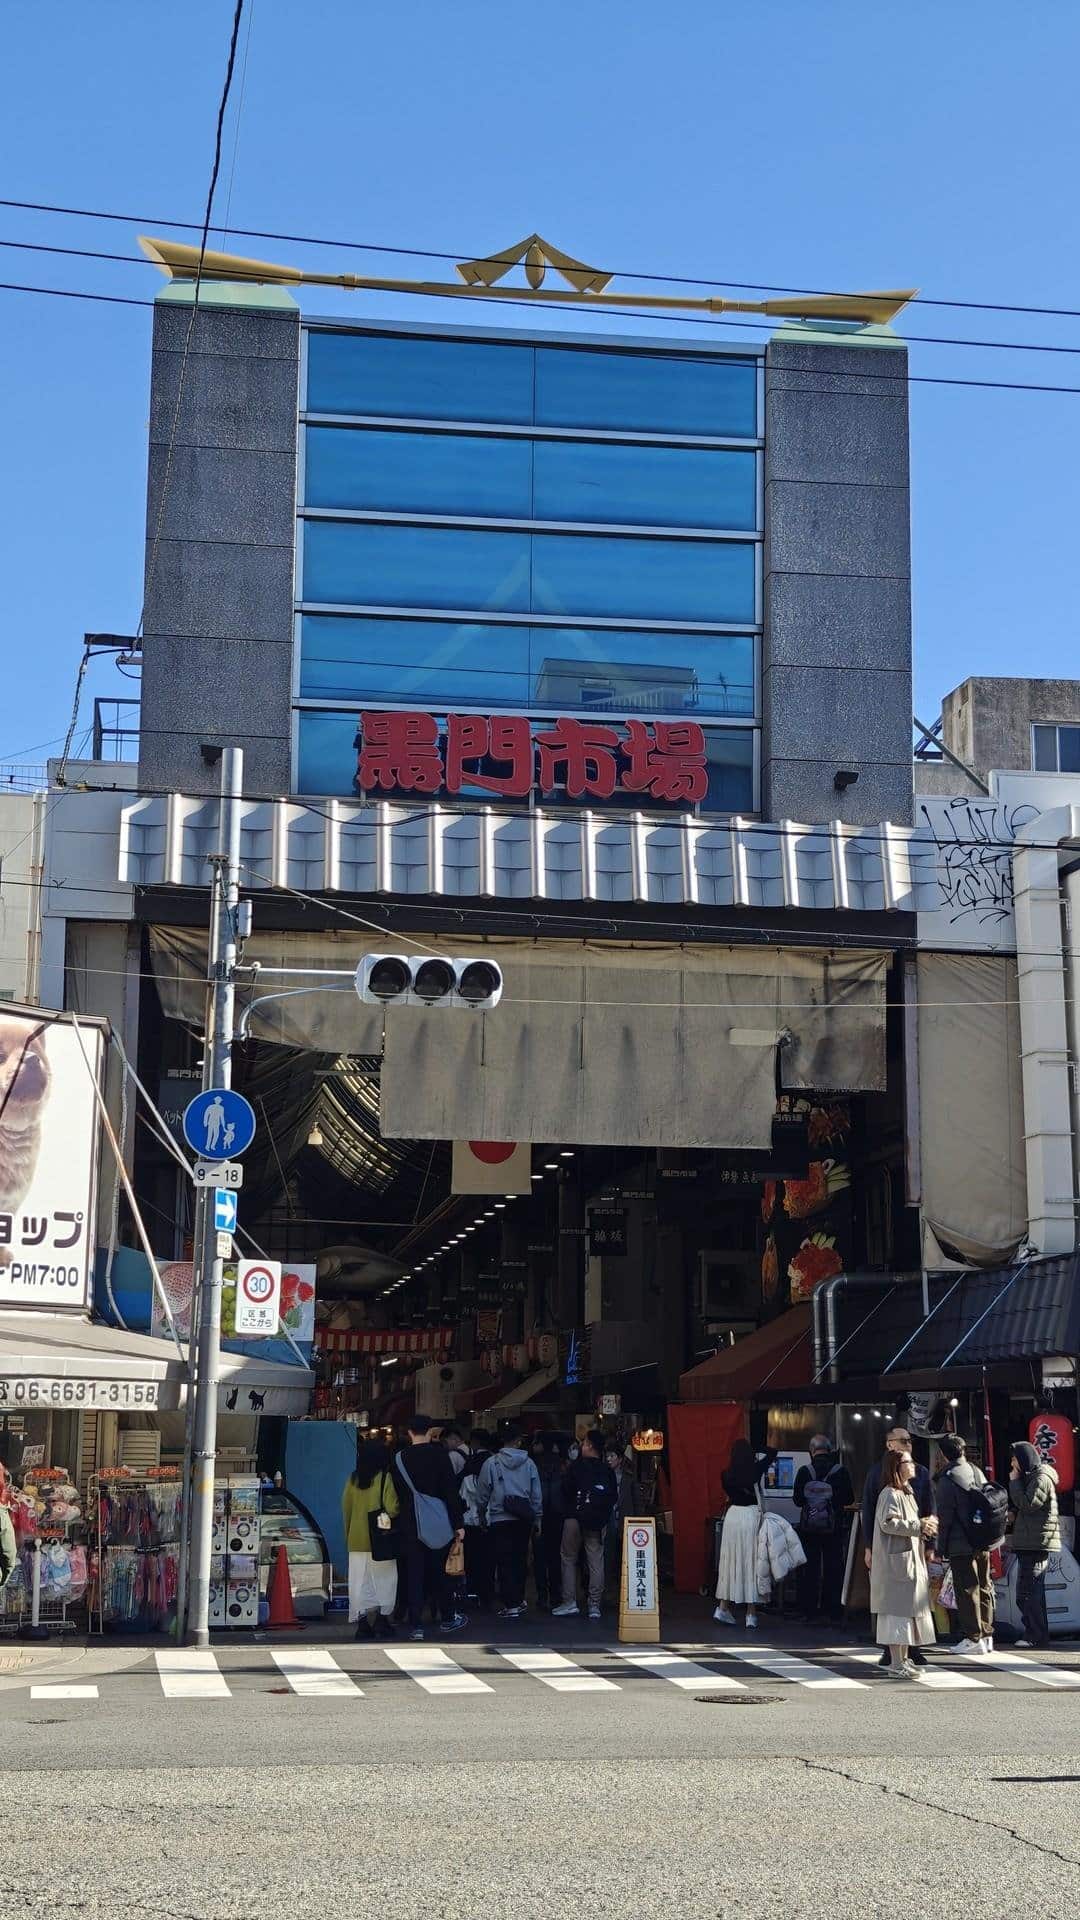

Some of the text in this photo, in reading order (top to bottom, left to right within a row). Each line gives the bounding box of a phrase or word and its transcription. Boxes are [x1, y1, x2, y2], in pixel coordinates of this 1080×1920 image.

[250, 1276, 267, 1293] 30
[242, 1317, 272, 1328] ここから
[14, 1381, 155, 1402] 06-6631-3158
[635, 1549, 647, 1607] 車両進入禁止
